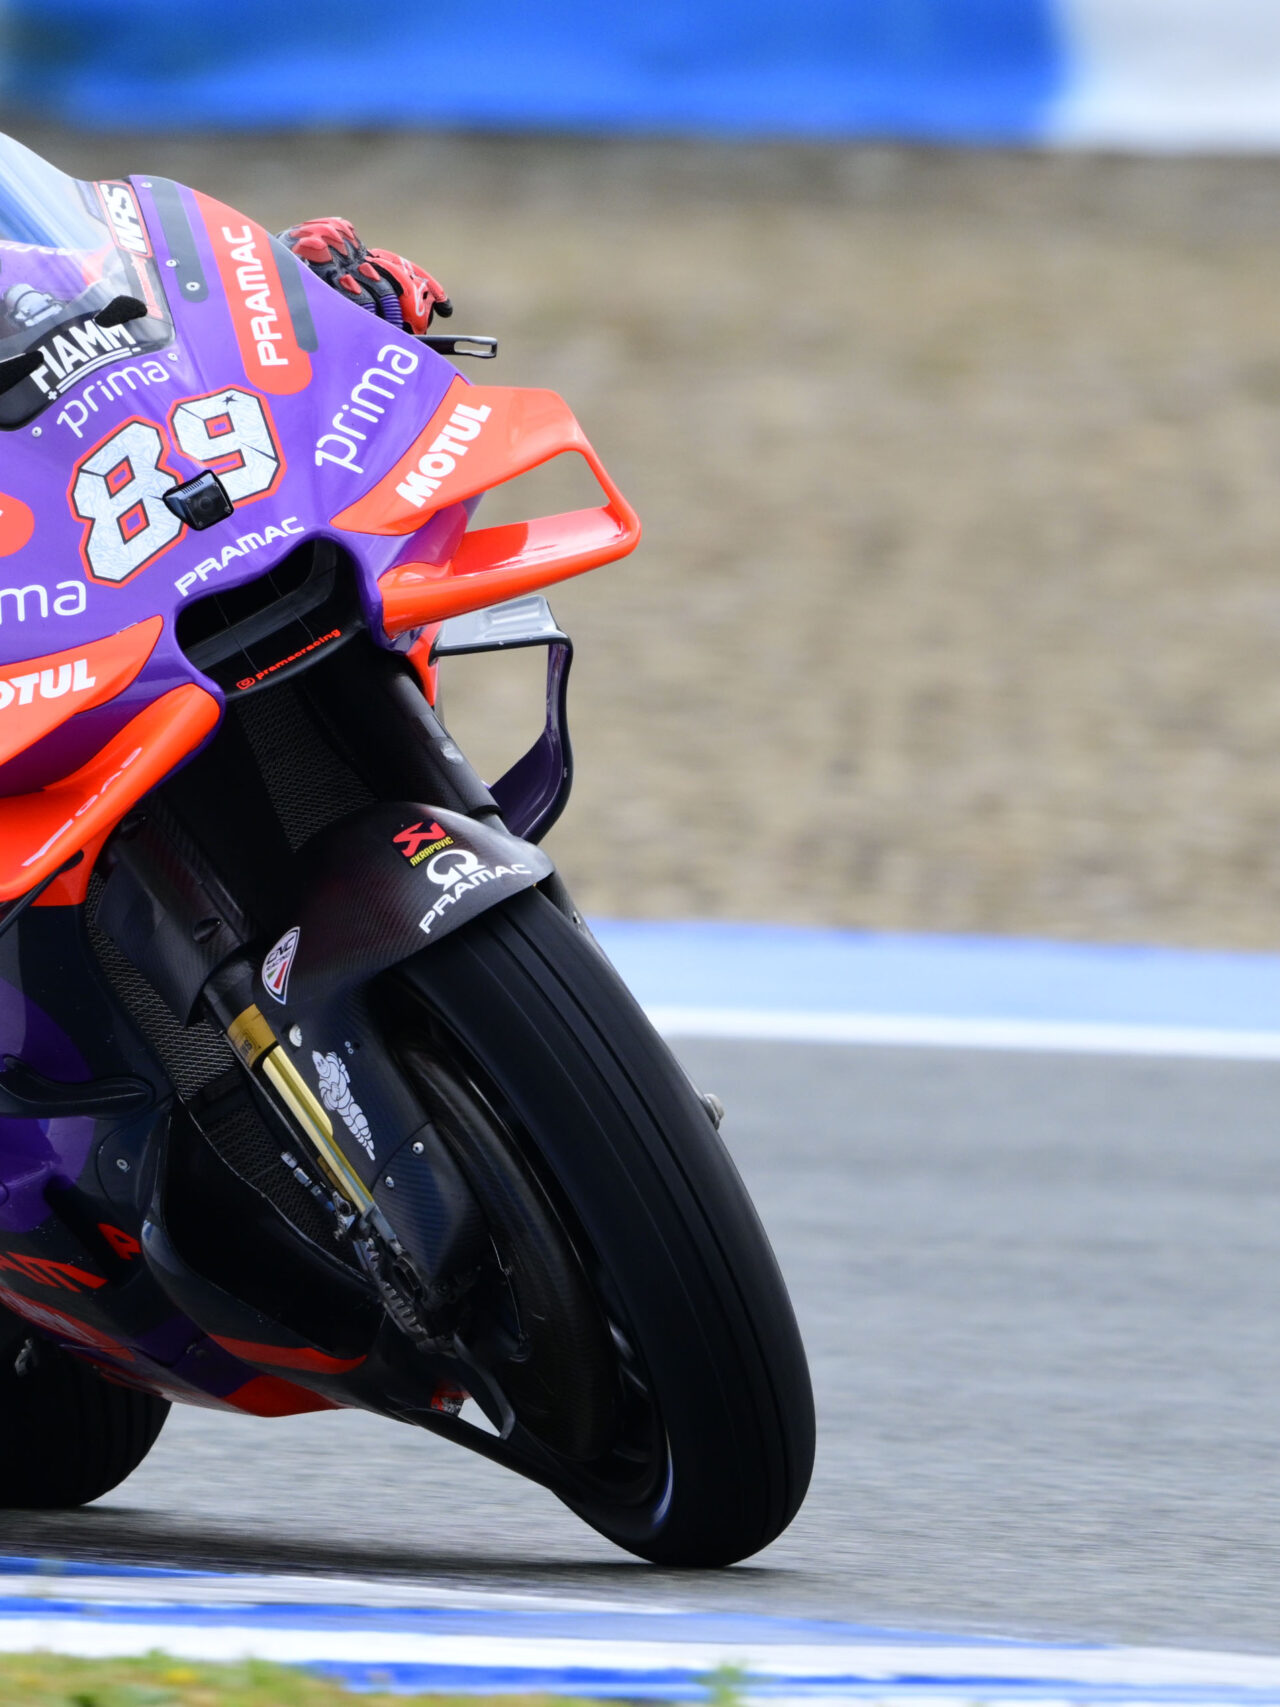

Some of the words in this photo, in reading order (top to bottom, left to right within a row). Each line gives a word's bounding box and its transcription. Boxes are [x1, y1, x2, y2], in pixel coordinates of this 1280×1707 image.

[99, 183, 148, 254] WRS
[221, 224, 289, 367] PRAMAC
[56, 359, 170, 439] prima
[314, 343, 419, 475] prima
[67, 384, 287, 588] 89
[395, 401, 492, 508] MOTUL
[174, 515, 305, 597] PRAMAC
[418, 862, 533, 935] PRAMAC
